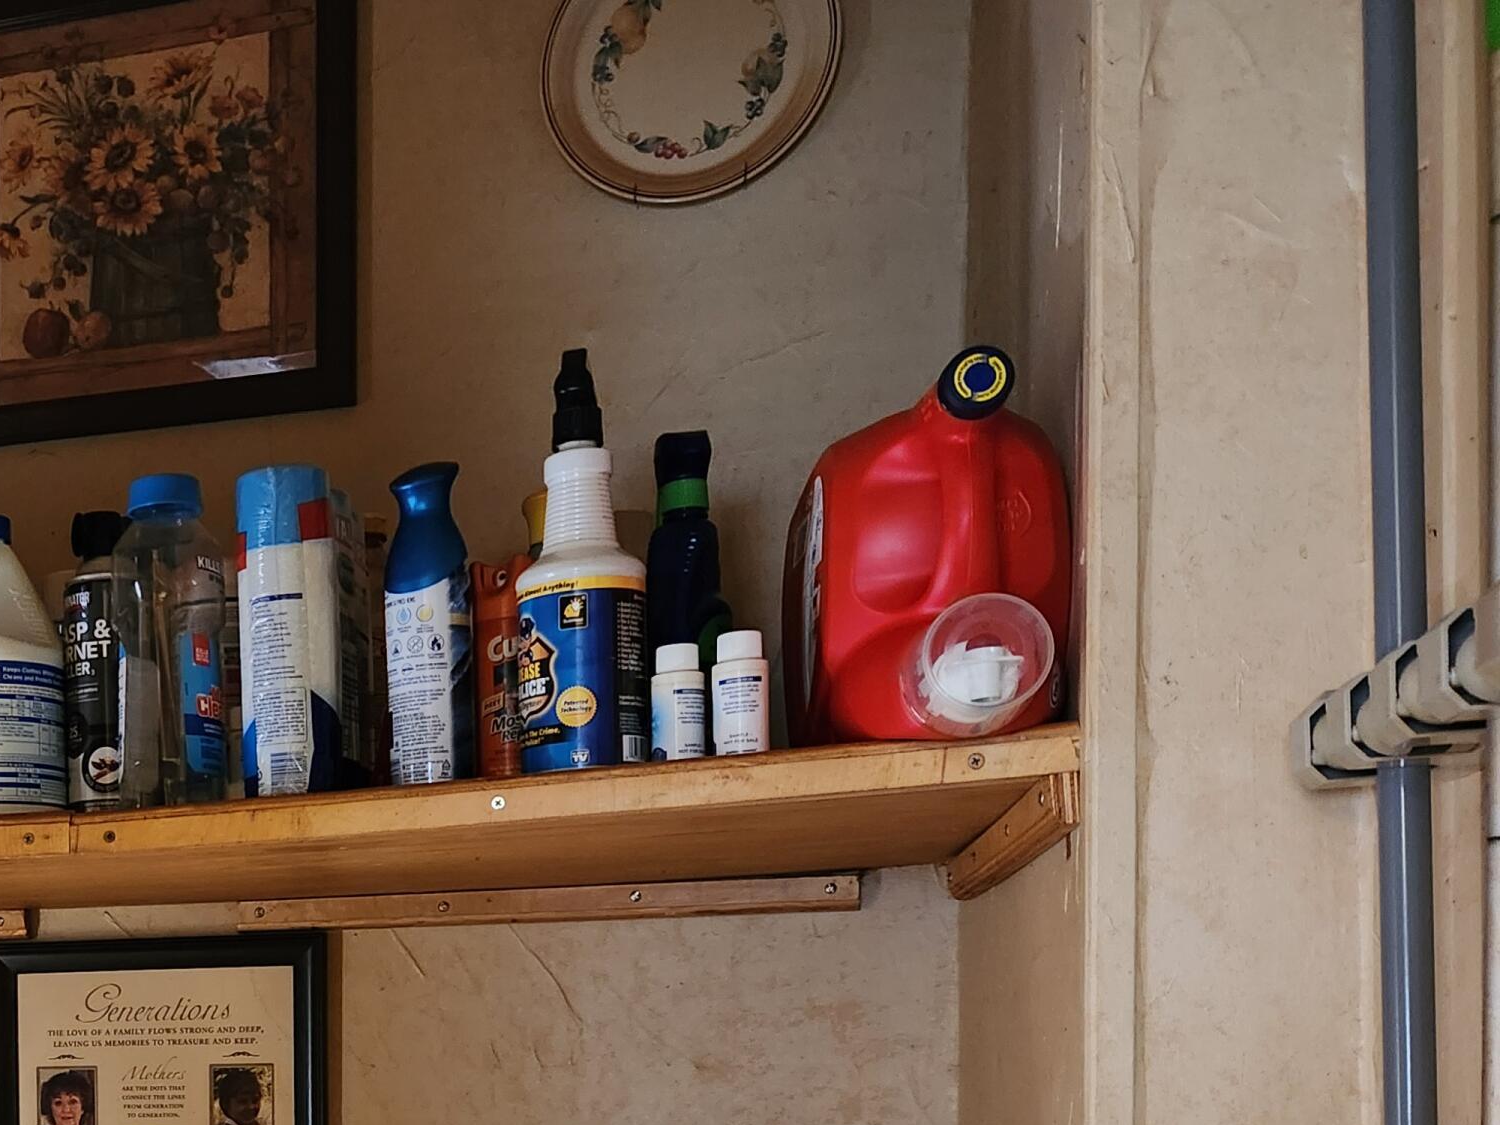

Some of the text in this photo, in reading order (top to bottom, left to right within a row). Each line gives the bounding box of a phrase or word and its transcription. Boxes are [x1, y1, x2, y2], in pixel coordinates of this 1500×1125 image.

[94, 618, 111, 638] &
[75, 983, 231, 1024] Generations
[48, 1029, 64, 1037] THE
[148, 1027, 177, 1035] FLOWS
[217, 1026, 236, 1034] AND
[238, 1026, 265, 1034] DEEP,
[53, 1040, 89, 1048] LEAVING
[104, 1039, 150, 1047] MEMORIES
[234, 1037, 259, 1045] KEEP.
[122, 1056, 187, 1081] Mothers
